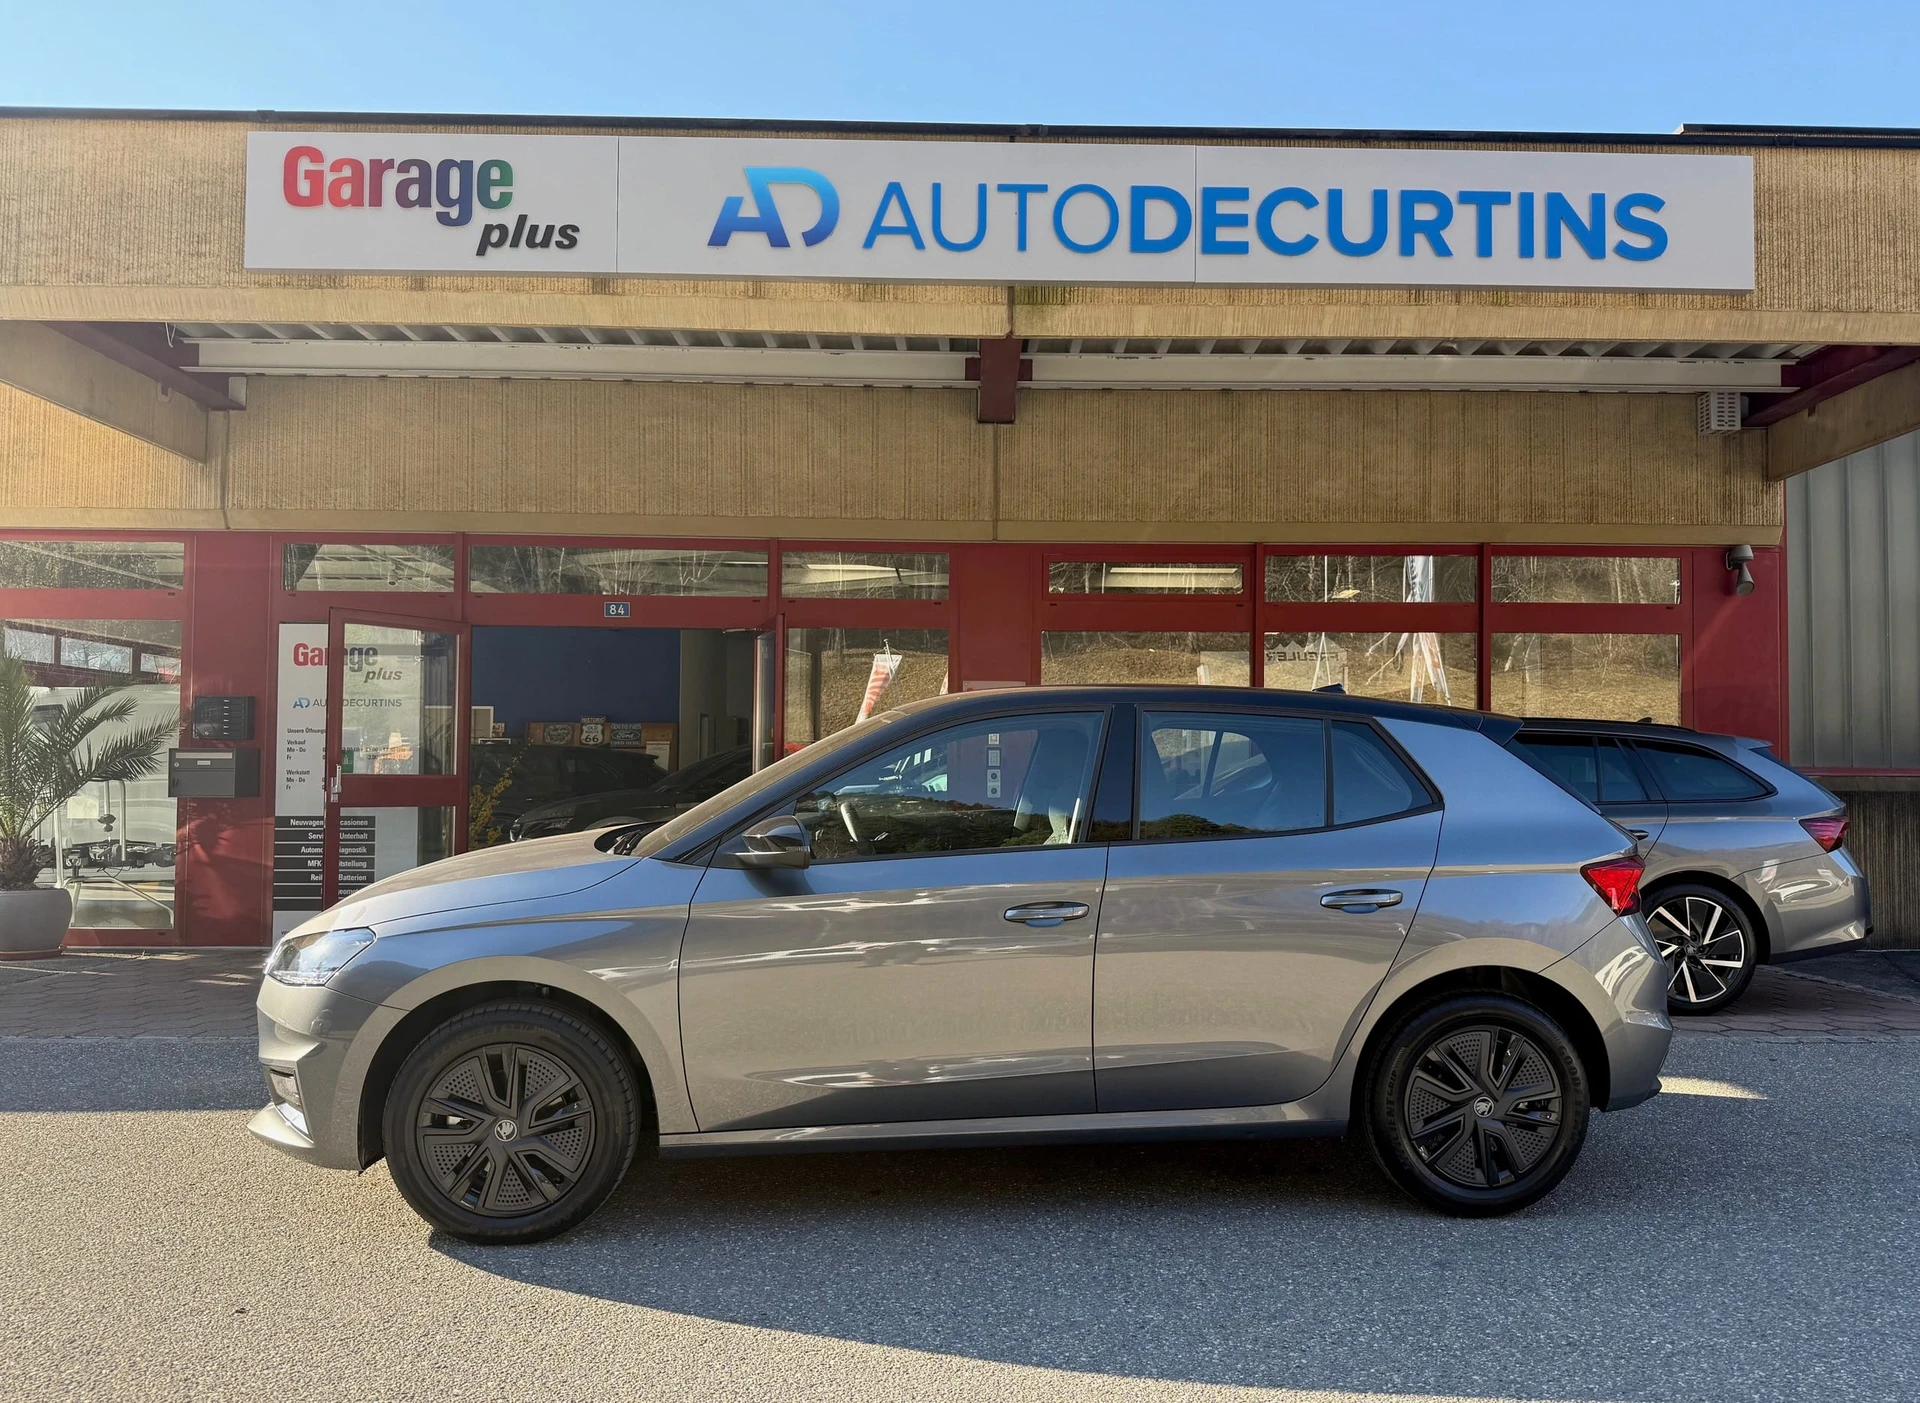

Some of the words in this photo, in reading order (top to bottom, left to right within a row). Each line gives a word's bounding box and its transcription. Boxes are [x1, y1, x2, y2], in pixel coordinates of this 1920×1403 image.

[283, 146, 514, 227] Garage
[862, 181, 1669, 262] AUTODECURTINS
[475, 214, 580, 257] plus
[609, 604, 625, 615] 84
[293, 642, 379, 673] Gage
[363, 667, 403, 684] plus
[312, 698, 403, 708] AUDECURTINS
[584, 734, 599, 743] 66
[290, 818, 324, 828] Neuwagen
[340, 818, 369, 826] casionen
[308, 832, 324, 840] Servi
[339, 832, 368, 840] Unterhalt
